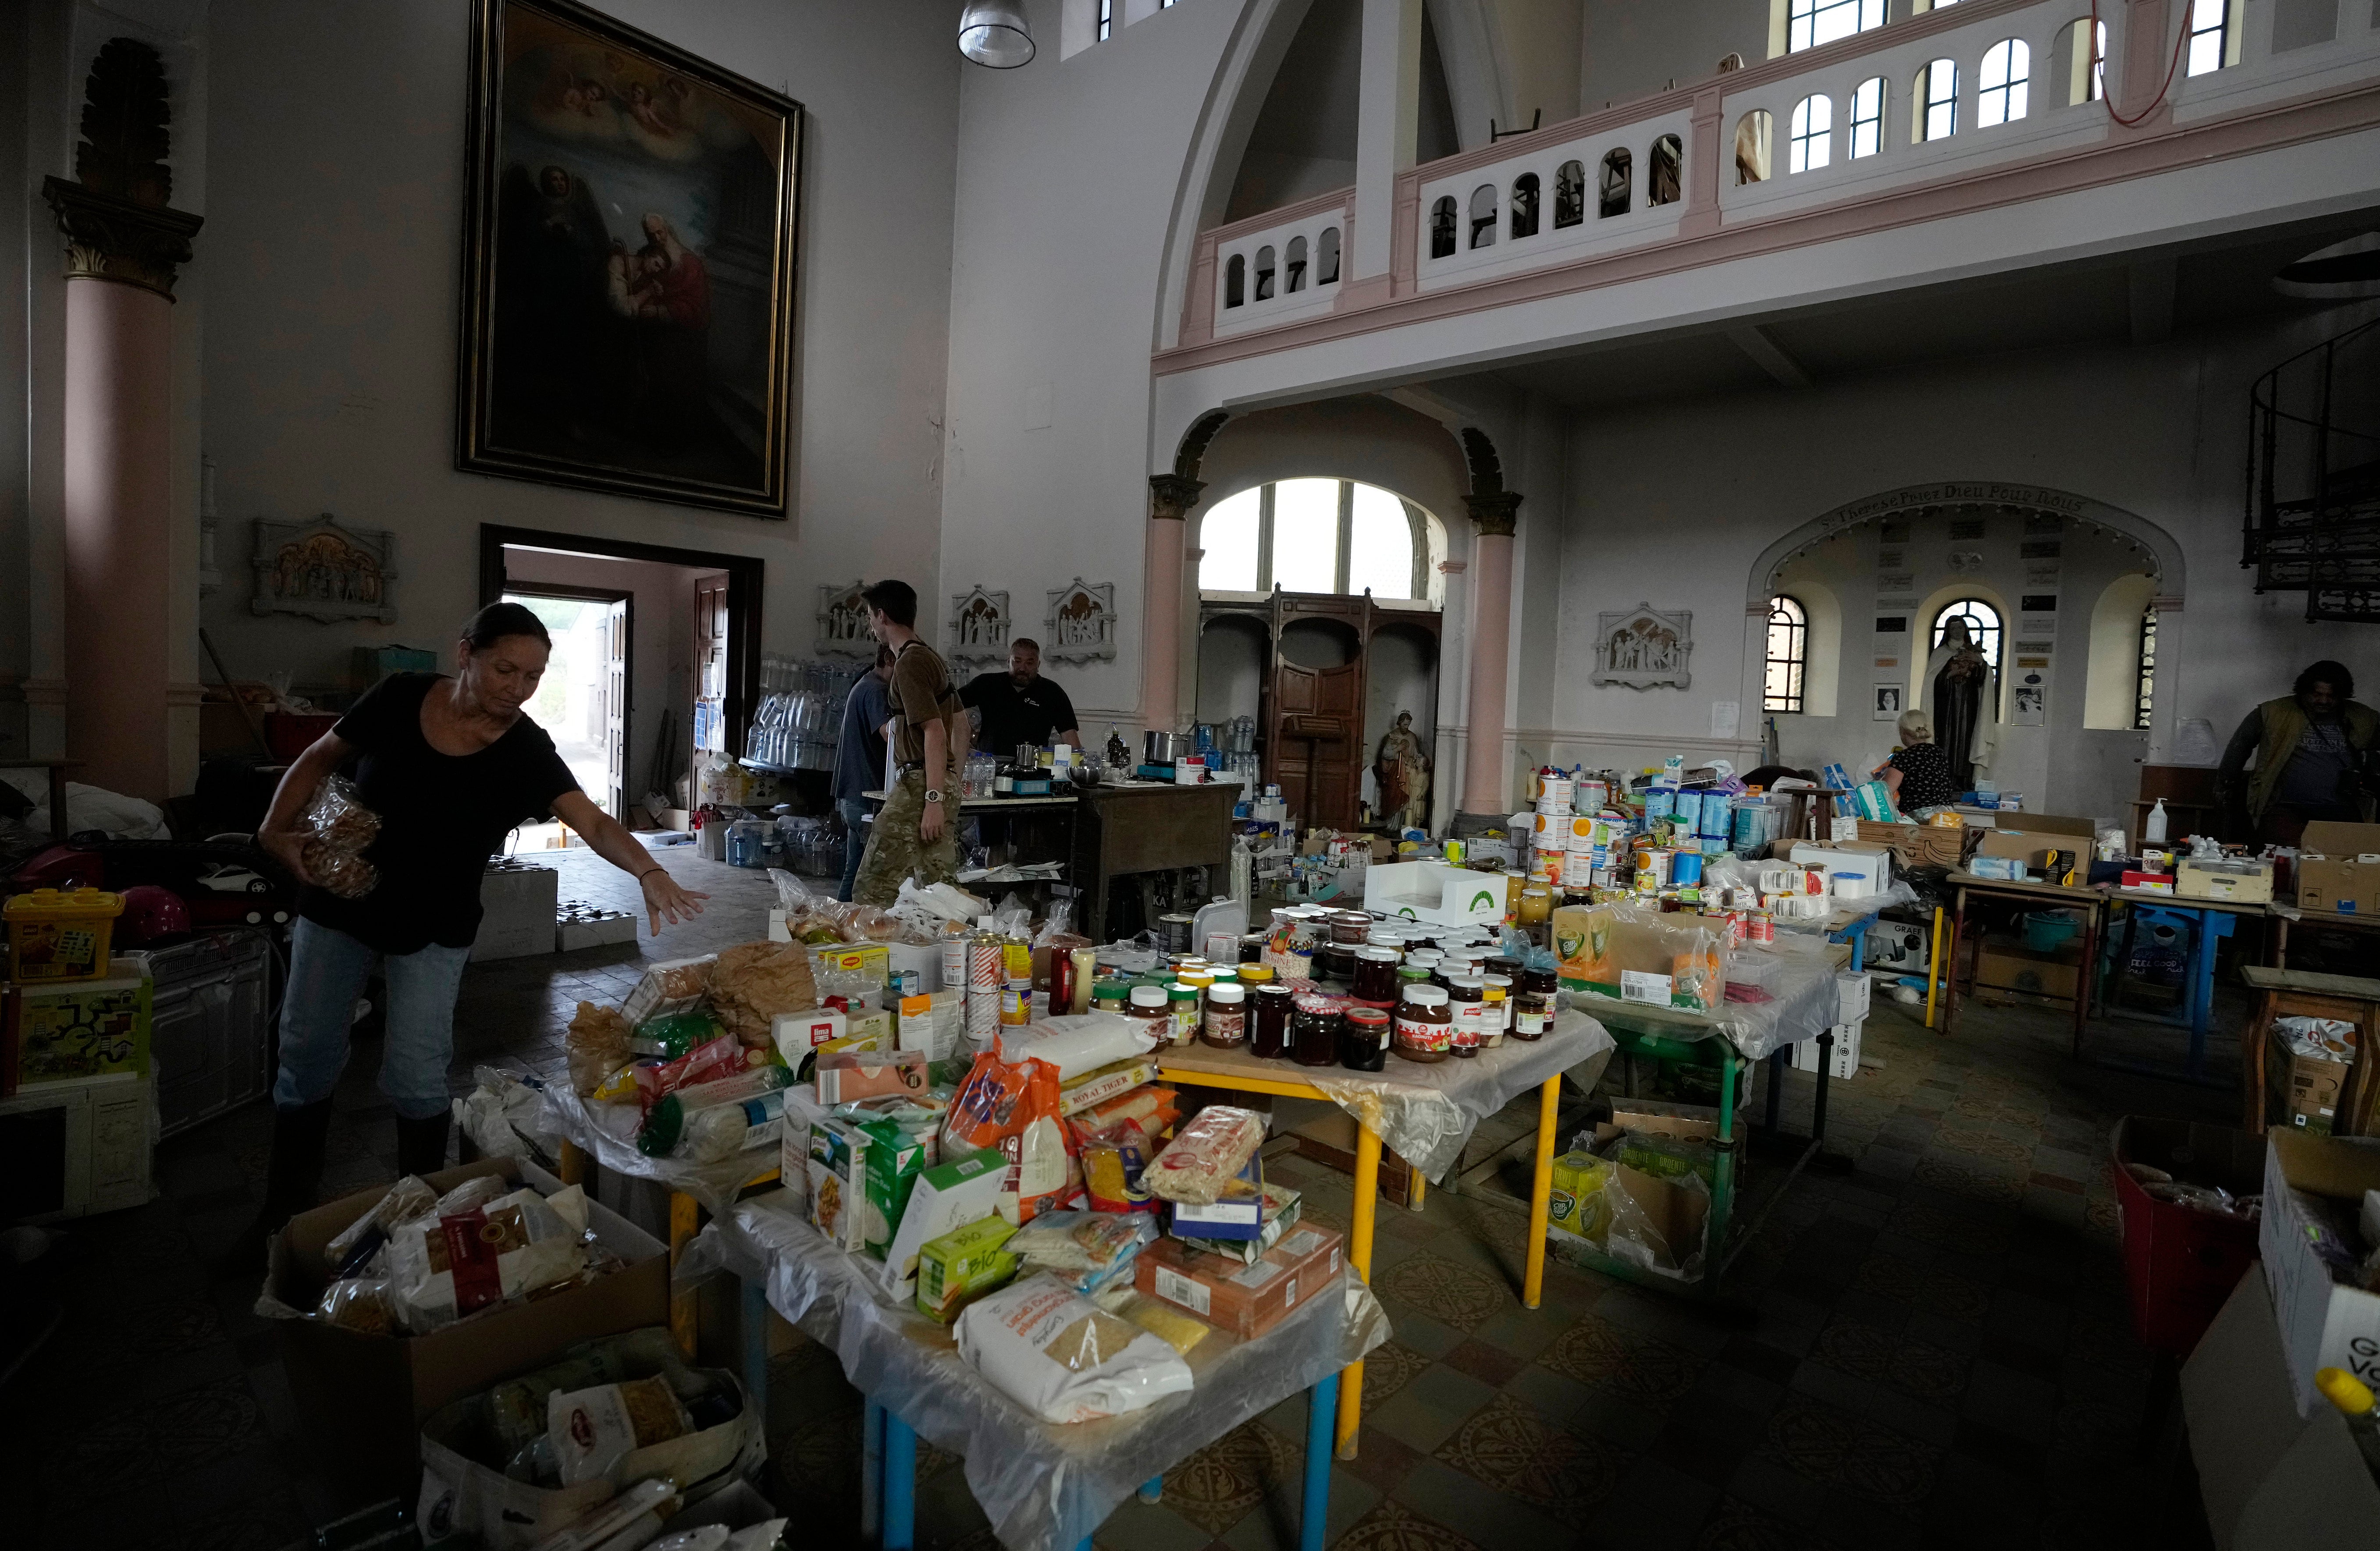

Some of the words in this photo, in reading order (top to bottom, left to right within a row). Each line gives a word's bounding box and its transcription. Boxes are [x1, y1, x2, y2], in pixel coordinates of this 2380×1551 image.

[1900, 490, 1939, 505] Priez
[1945, 486, 1985, 498] Dieu
[2035, 490, 2085, 511] Nous
[1246, 825, 1259, 834] MAES
[1563, 943, 1577, 952] SOUP
[1264, 954, 1291, 966] TAGINE
[1073, 1087, 1100, 1104] ROYAL
[1103, 1075, 1129, 1094] TIGER
[1623, 1149, 1649, 1164] GROENTE
[1659, 1156, 1686, 1172] GROENTE
[1553, 1206, 1567, 1215] SOUP
